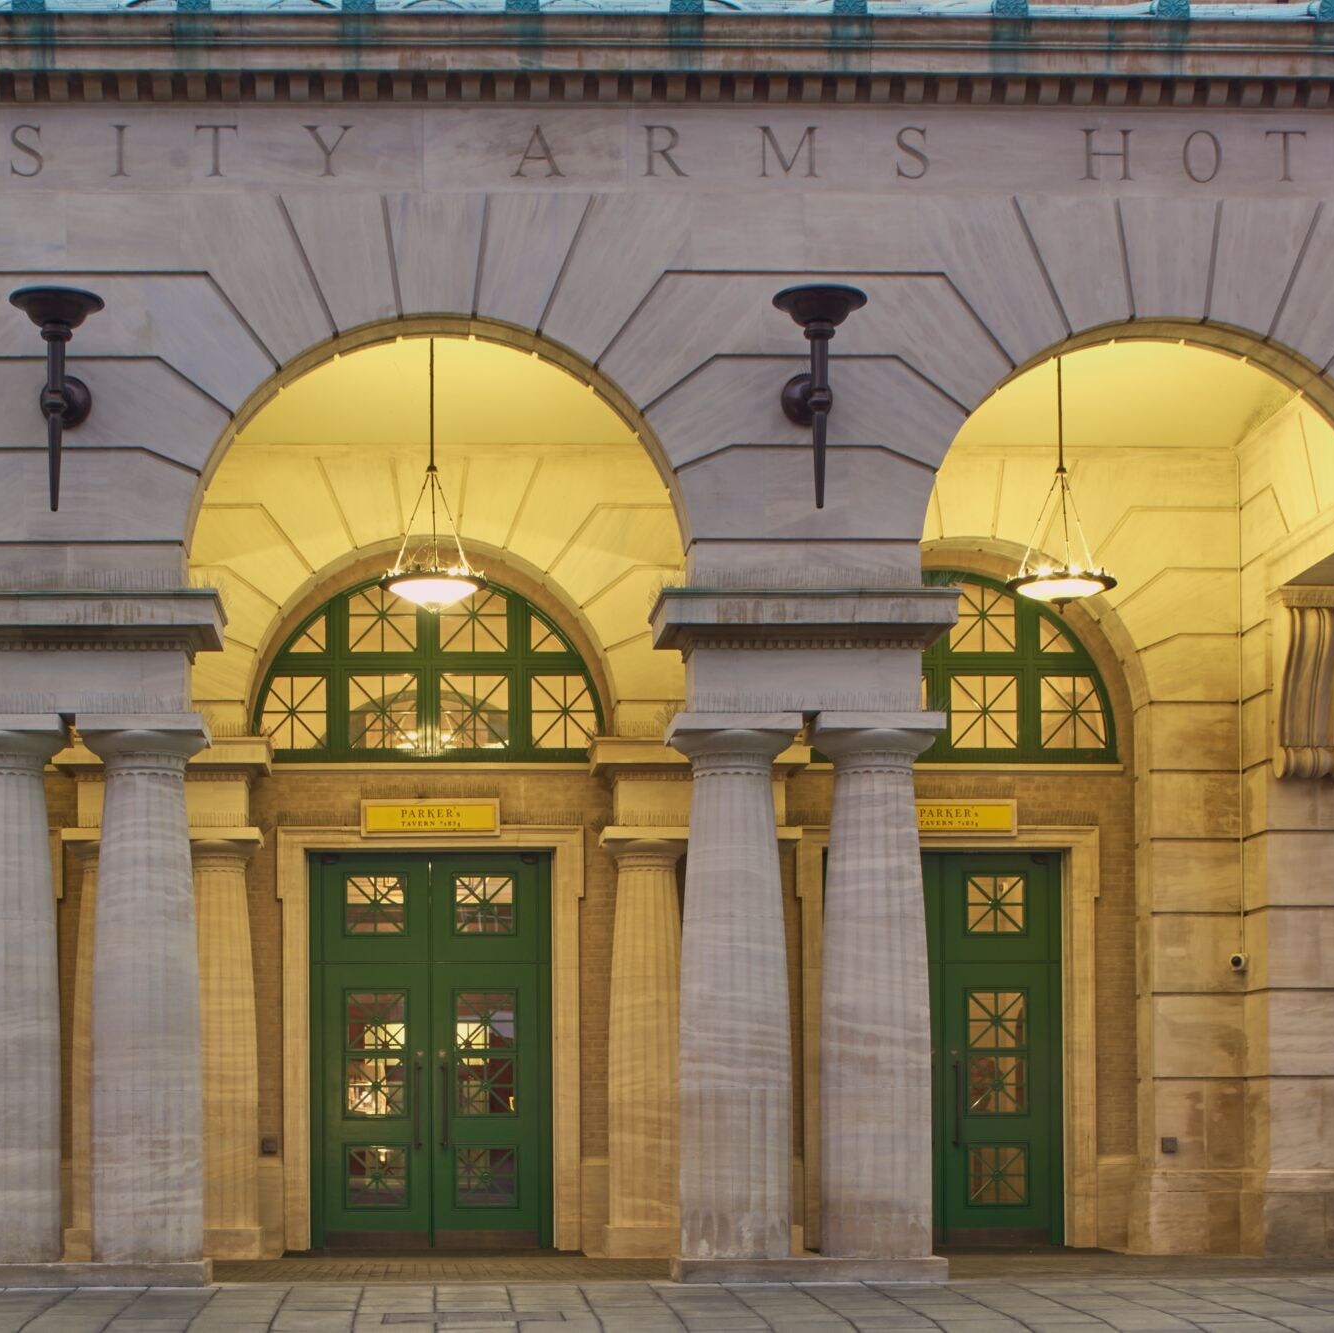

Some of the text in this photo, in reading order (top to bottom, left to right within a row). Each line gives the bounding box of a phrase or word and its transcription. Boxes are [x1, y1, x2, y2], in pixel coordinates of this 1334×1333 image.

[510, 123, 931, 180] ARMS
[400, 806, 461, 818] PARKER's
[400, 820, 436, 828] TAVERN
